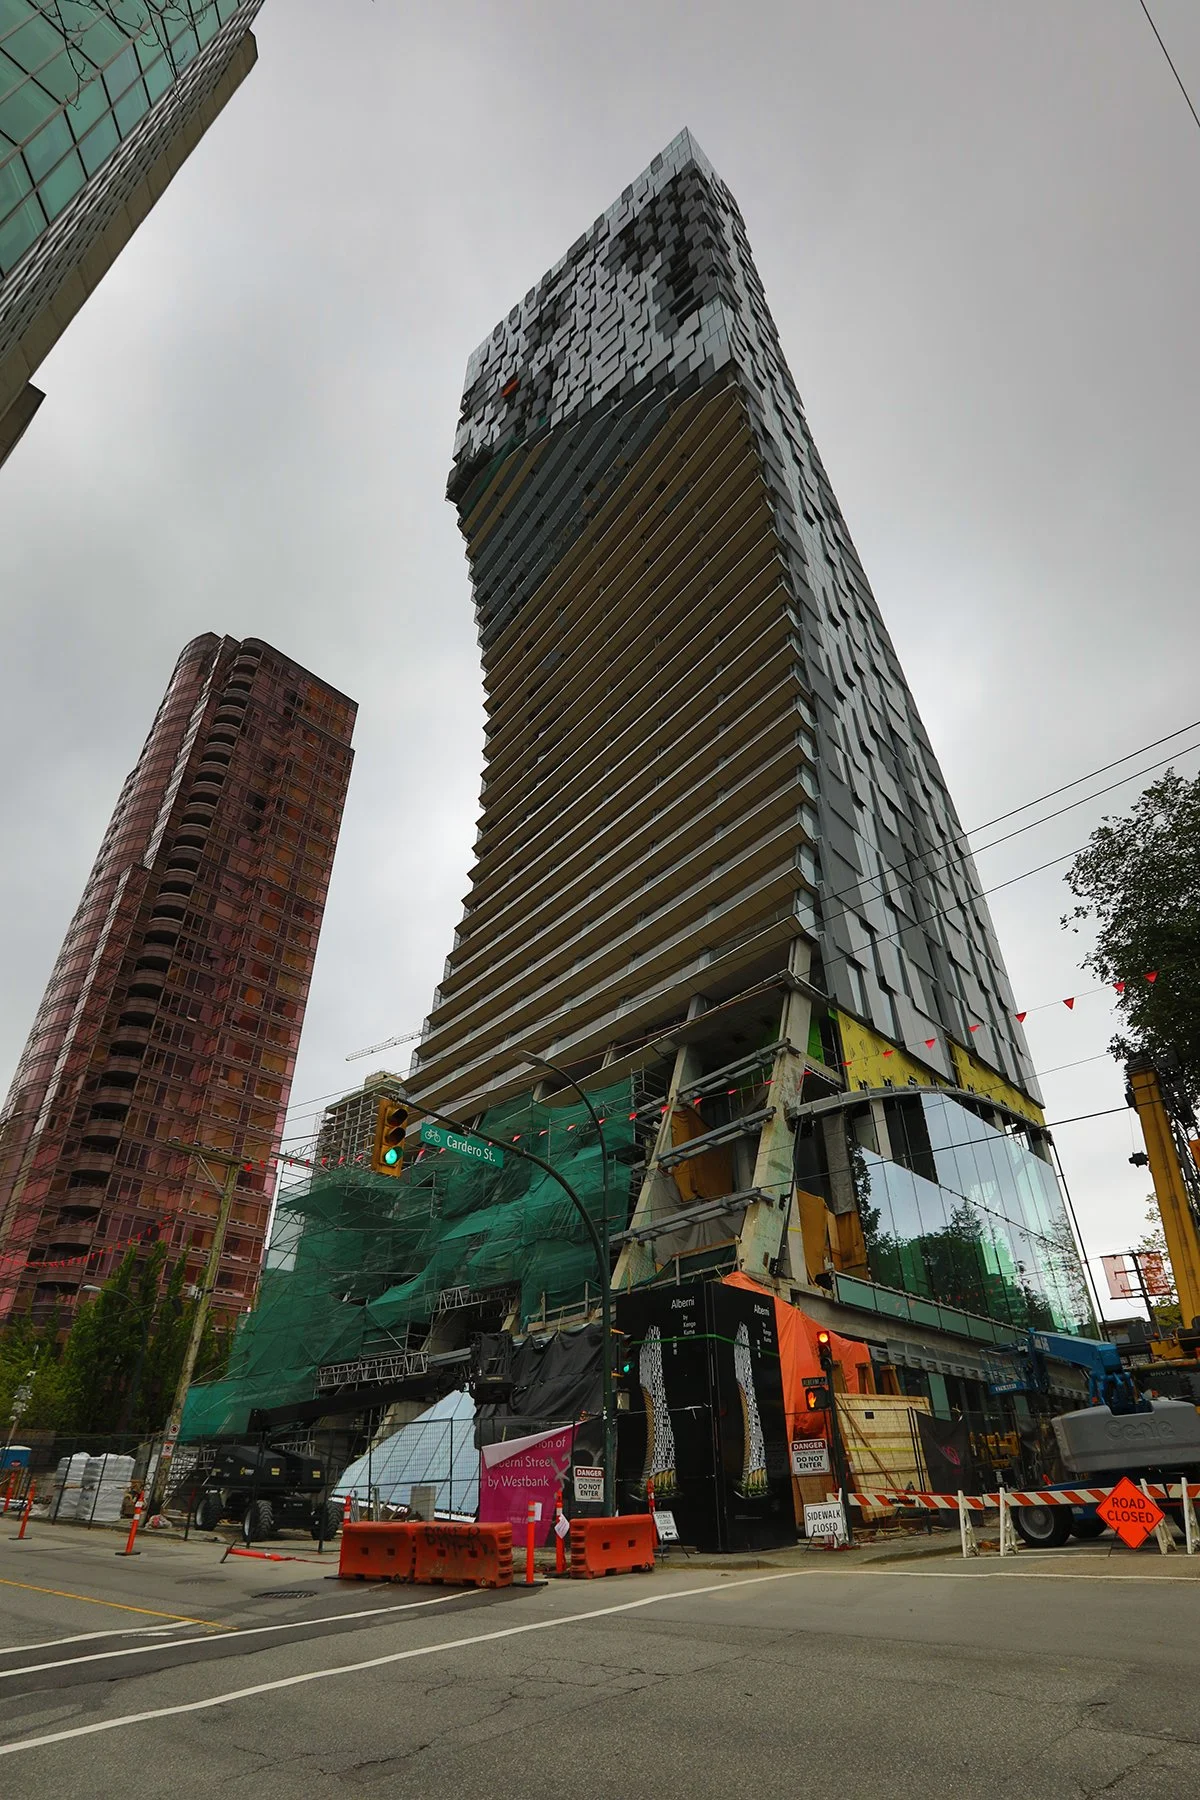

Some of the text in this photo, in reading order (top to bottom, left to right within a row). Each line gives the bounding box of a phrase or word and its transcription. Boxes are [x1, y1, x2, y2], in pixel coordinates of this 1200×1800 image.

[446, 1135, 496, 1162] Cardero St.
[670, 1296, 695, 1310] Alberni
[753, 1304, 770, 1317] Alberni
[1104, 1419, 1176, 1441] Genie
[555, 1436, 567, 1448] of
[793, 1441, 824, 1450] DANGER
[799, 1461, 822, 1469] ENTER
[576, 1468, 602, 1477] DANGER
[488, 1475, 550, 1490] by Westbank
[588, 1483, 601, 1491] NOT
[580, 1489, 599, 1497] ENTER
[1112, 1497, 1146, 1509] ROAD
[806, 1509, 841, 1521] SIDEWALK
[1106, 1510, 1154, 1523] CLOSED
[812, 1522, 838, 1533] CLOSED
